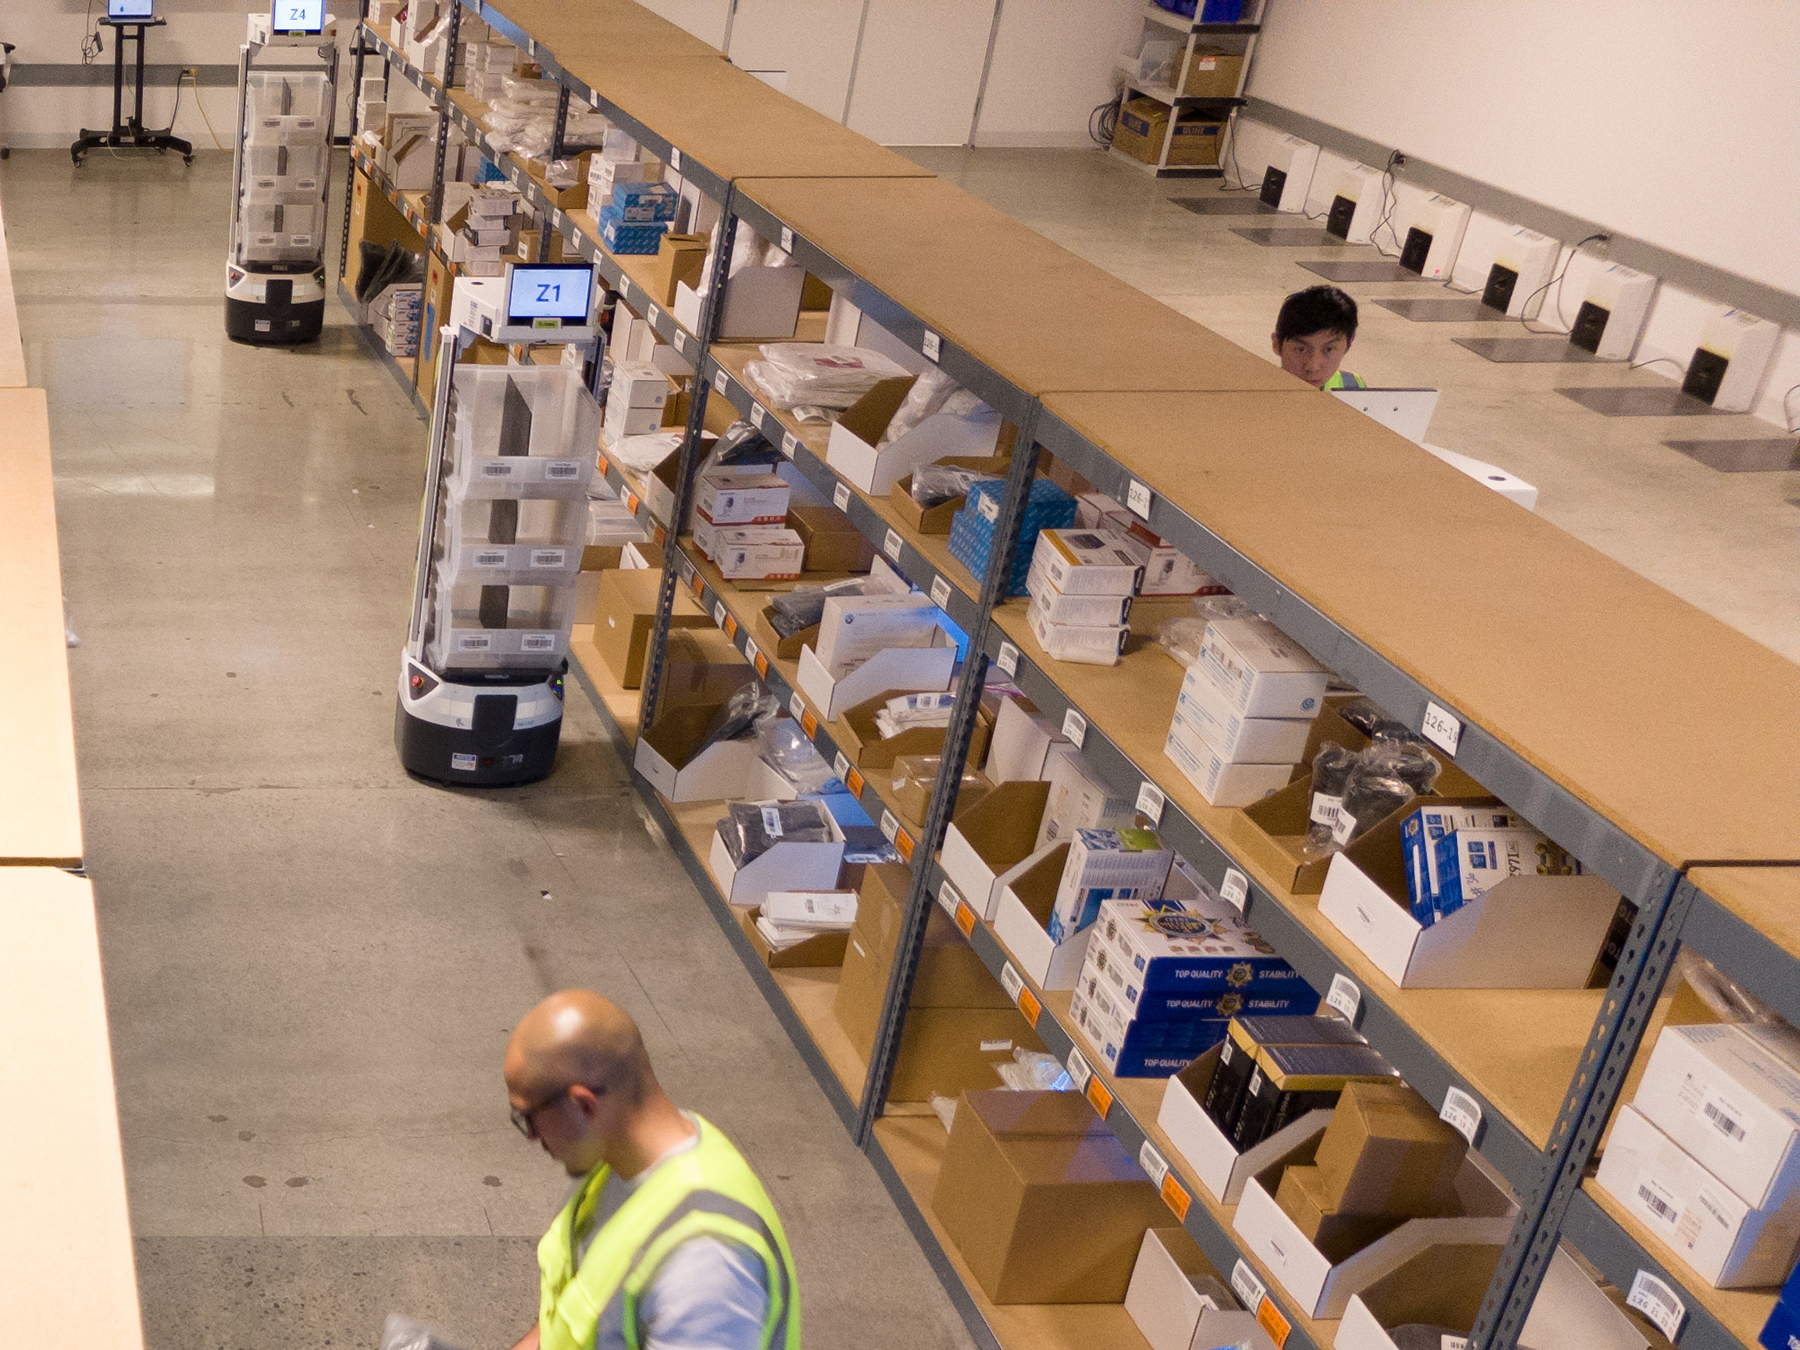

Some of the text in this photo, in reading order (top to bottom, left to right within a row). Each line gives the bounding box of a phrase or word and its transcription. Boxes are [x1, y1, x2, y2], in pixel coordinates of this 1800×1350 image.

[289, 8, 306, 21] Z4
[535, 284, 562, 302] Z1
[1175, 969, 1189, 979] TOP
[1191, 969, 1223, 979] QUALITY
[1167, 999, 1289, 1008] TOP QUALITY STABILITY
[1144, 1059, 1157, 1068] TOP
[1632, 1295, 1648, 1311] 126
[1650, 1306, 1659, 1318] 21
